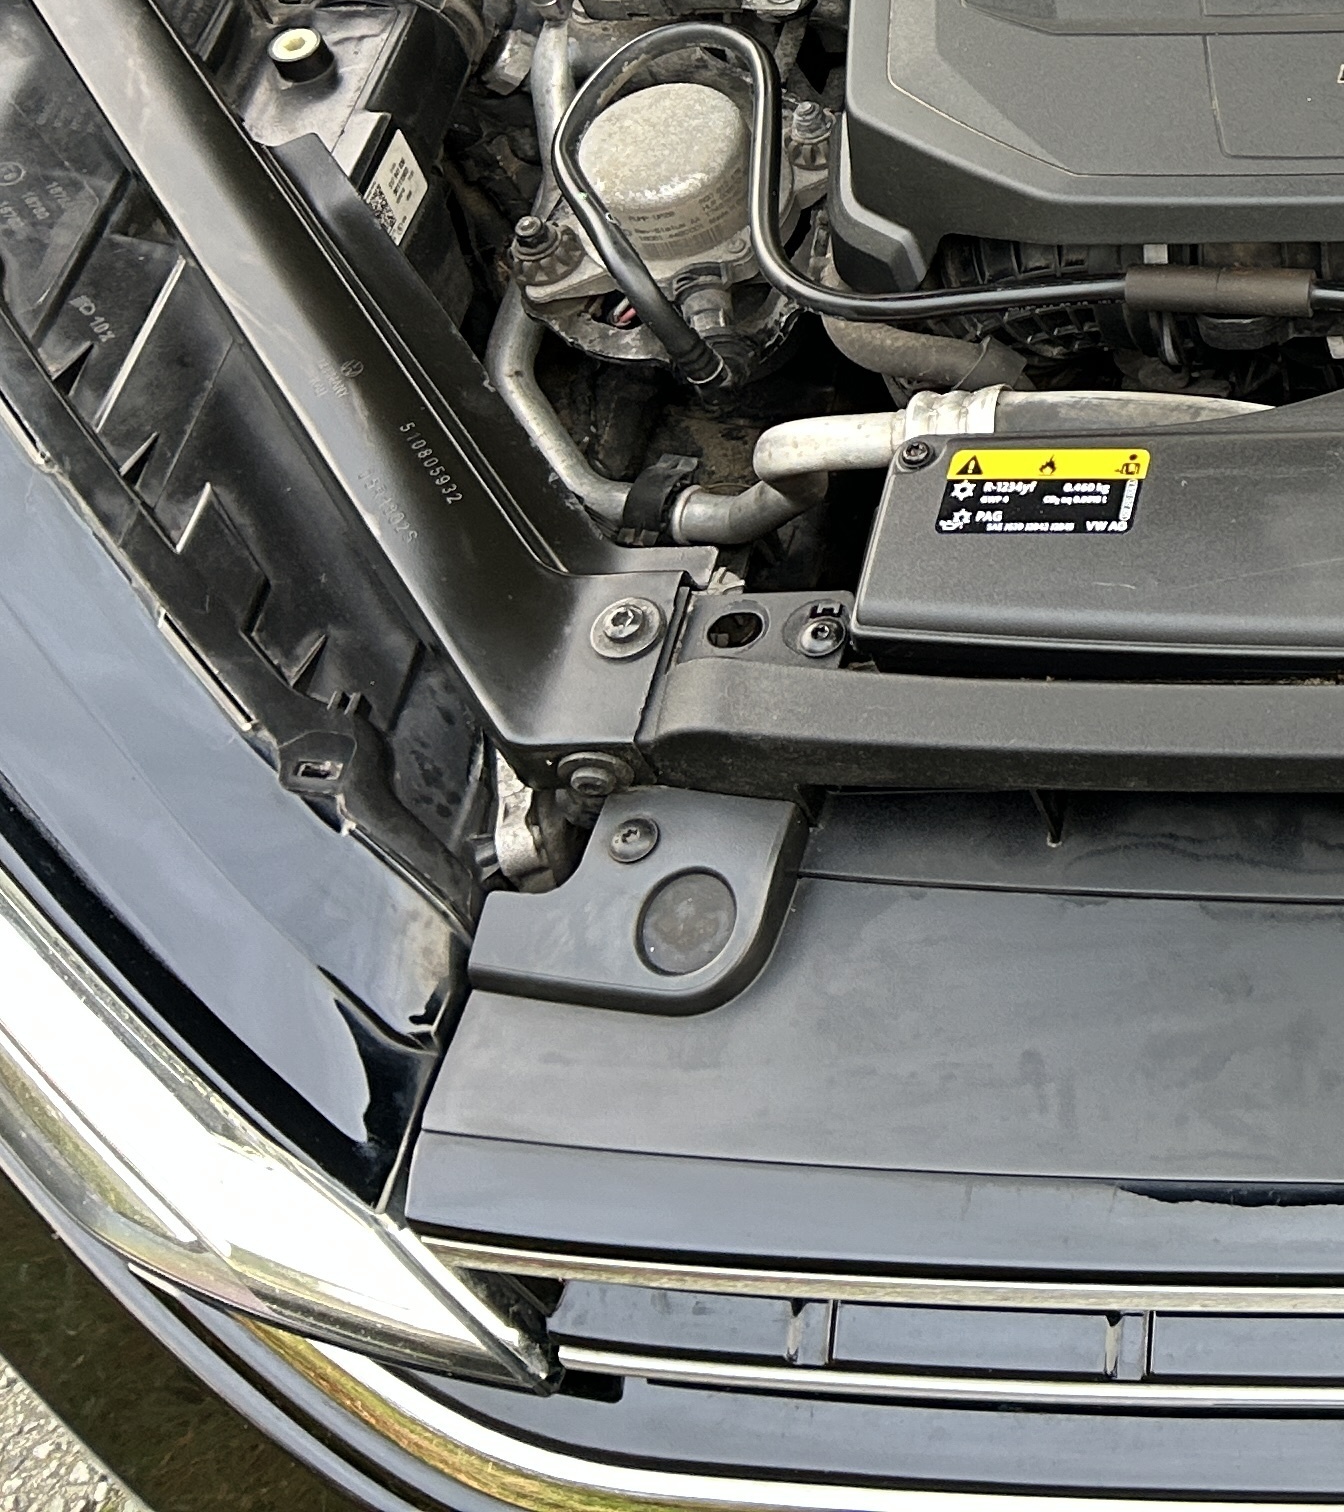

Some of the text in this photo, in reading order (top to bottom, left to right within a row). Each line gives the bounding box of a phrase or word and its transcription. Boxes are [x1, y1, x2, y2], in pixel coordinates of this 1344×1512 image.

[400, 421, 463, 505] 510805932
[975, 510, 1003, 522] PAG
[1086, 521, 1128, 532] VW AG
